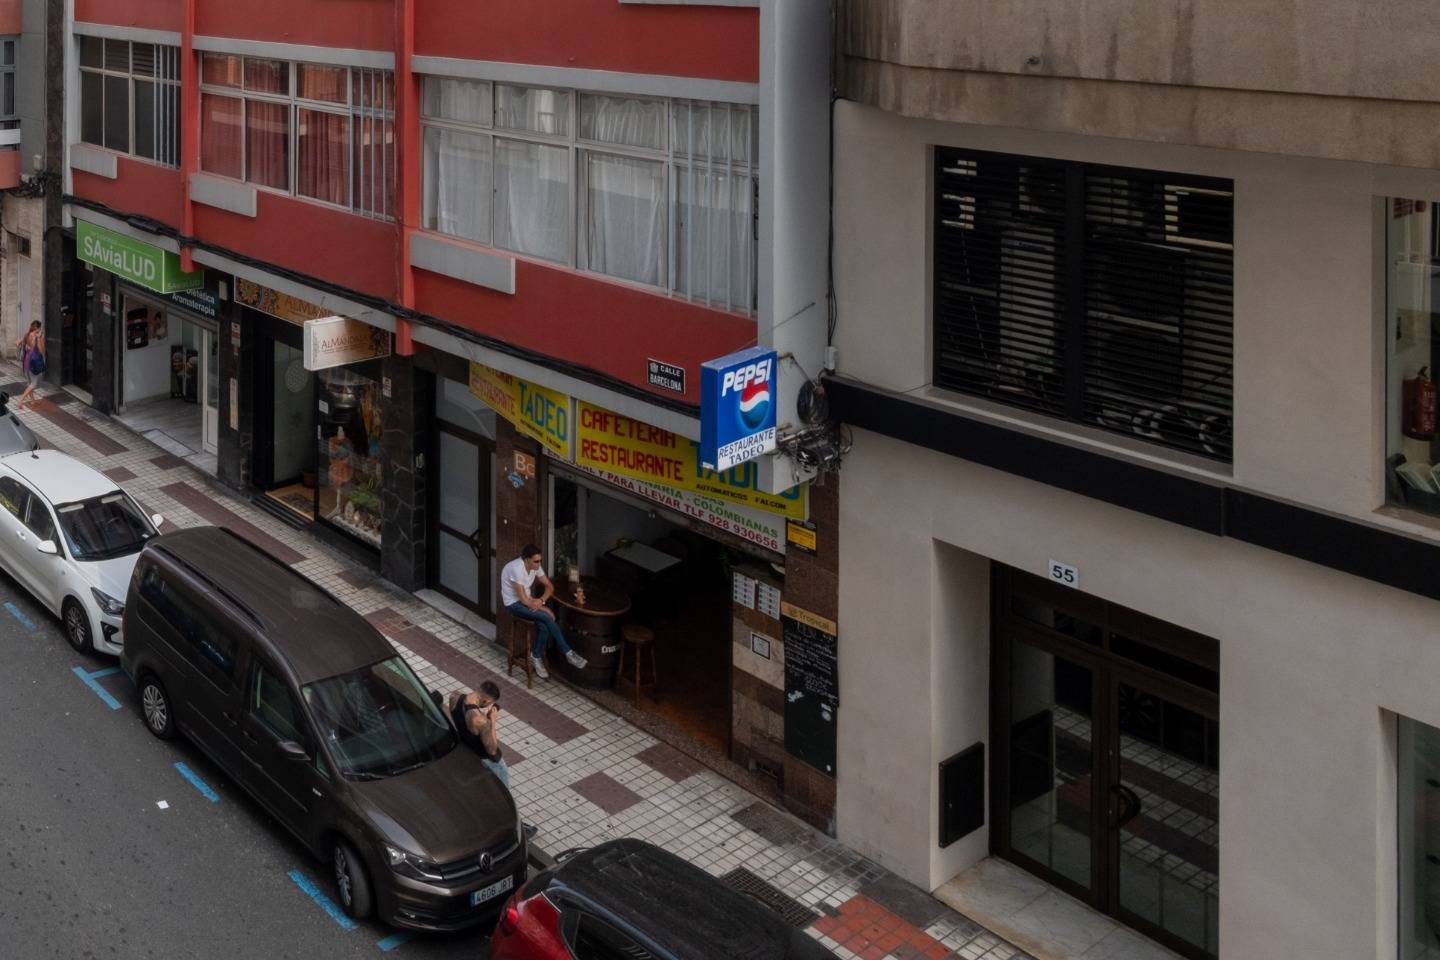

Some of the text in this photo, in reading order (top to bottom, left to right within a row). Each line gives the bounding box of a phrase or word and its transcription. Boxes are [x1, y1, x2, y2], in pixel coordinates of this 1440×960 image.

[83, 236, 155, 280] SAviaLUD
[172, 292, 215, 317] Aromaterapia
[649, 373, 682, 391] BARCELONA
[660, 365, 681, 377] CALLE
[721, 358, 772, 397] PEPSI
[519, 381, 567, 441] TADEO
[581, 438, 684, 482] RESTAURANTE
[719, 428, 774, 458] RESTAURANTE
[729, 444, 765, 465] TADEO
[607, 472, 635, 490] PARA
[638, 484, 680, 509] LLEVAR
[683, 503, 705, 519] TLF
[708, 513, 731, 530] 928
[733, 524, 778, 550] 930656
[693, 498, 778, 538] COLOMBIANAS
[1052, 565, 1074, 583] 55
